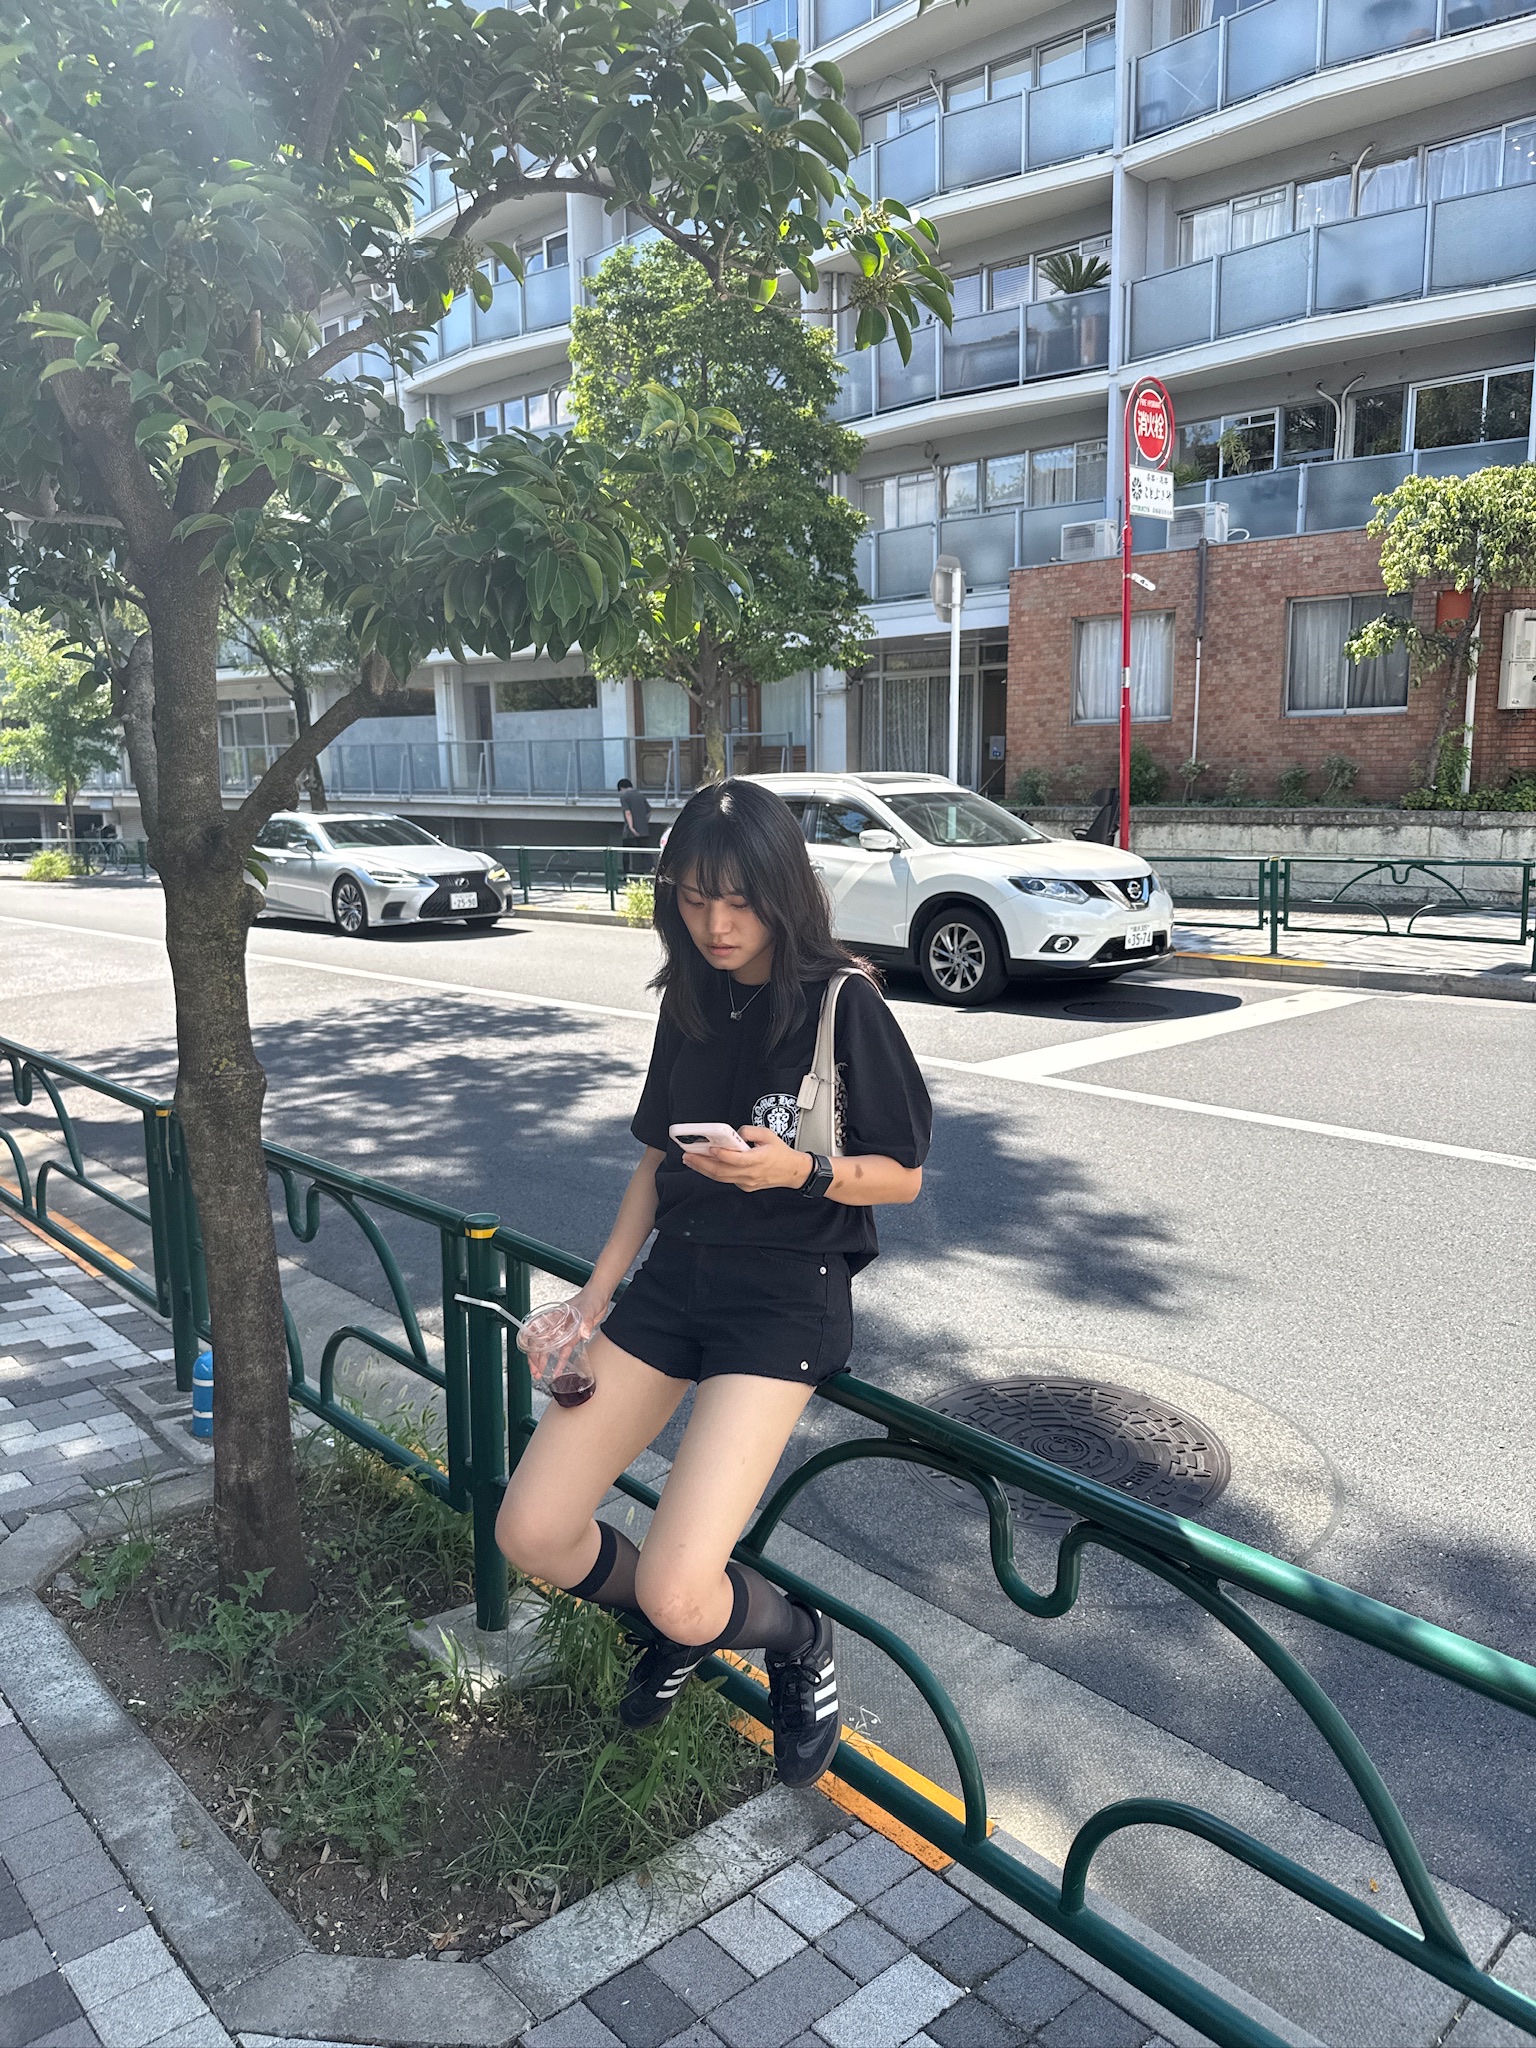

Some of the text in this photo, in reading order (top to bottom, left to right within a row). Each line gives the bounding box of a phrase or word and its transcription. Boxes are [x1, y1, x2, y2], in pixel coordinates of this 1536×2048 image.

[1137, 409, 1164, 440] 消火栓
[1131, 932, 1151, 947] 35-74
